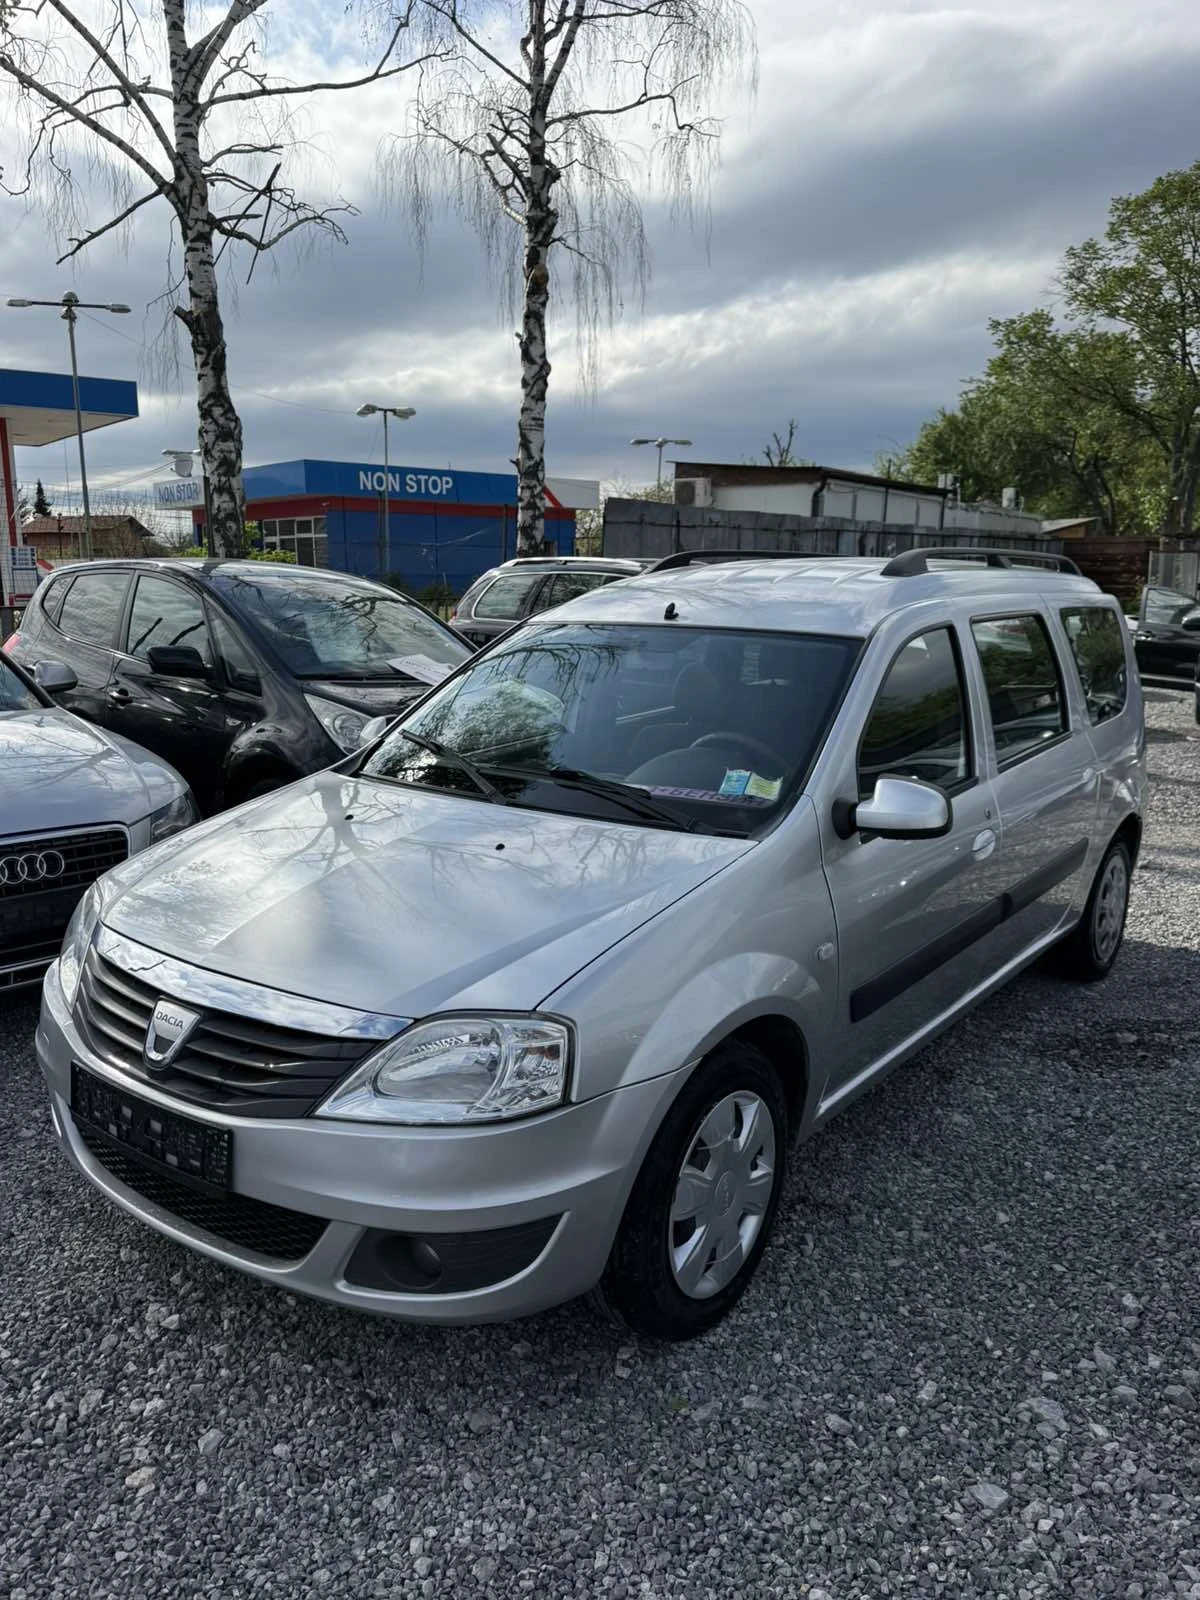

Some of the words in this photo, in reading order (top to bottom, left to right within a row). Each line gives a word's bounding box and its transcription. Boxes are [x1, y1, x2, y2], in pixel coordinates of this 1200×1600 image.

[359, 470, 400, 492] NON
[406, 473, 453, 495] STOP
[158, 485, 175, 504] NON
[155, 1010, 184, 1029] DACIA
